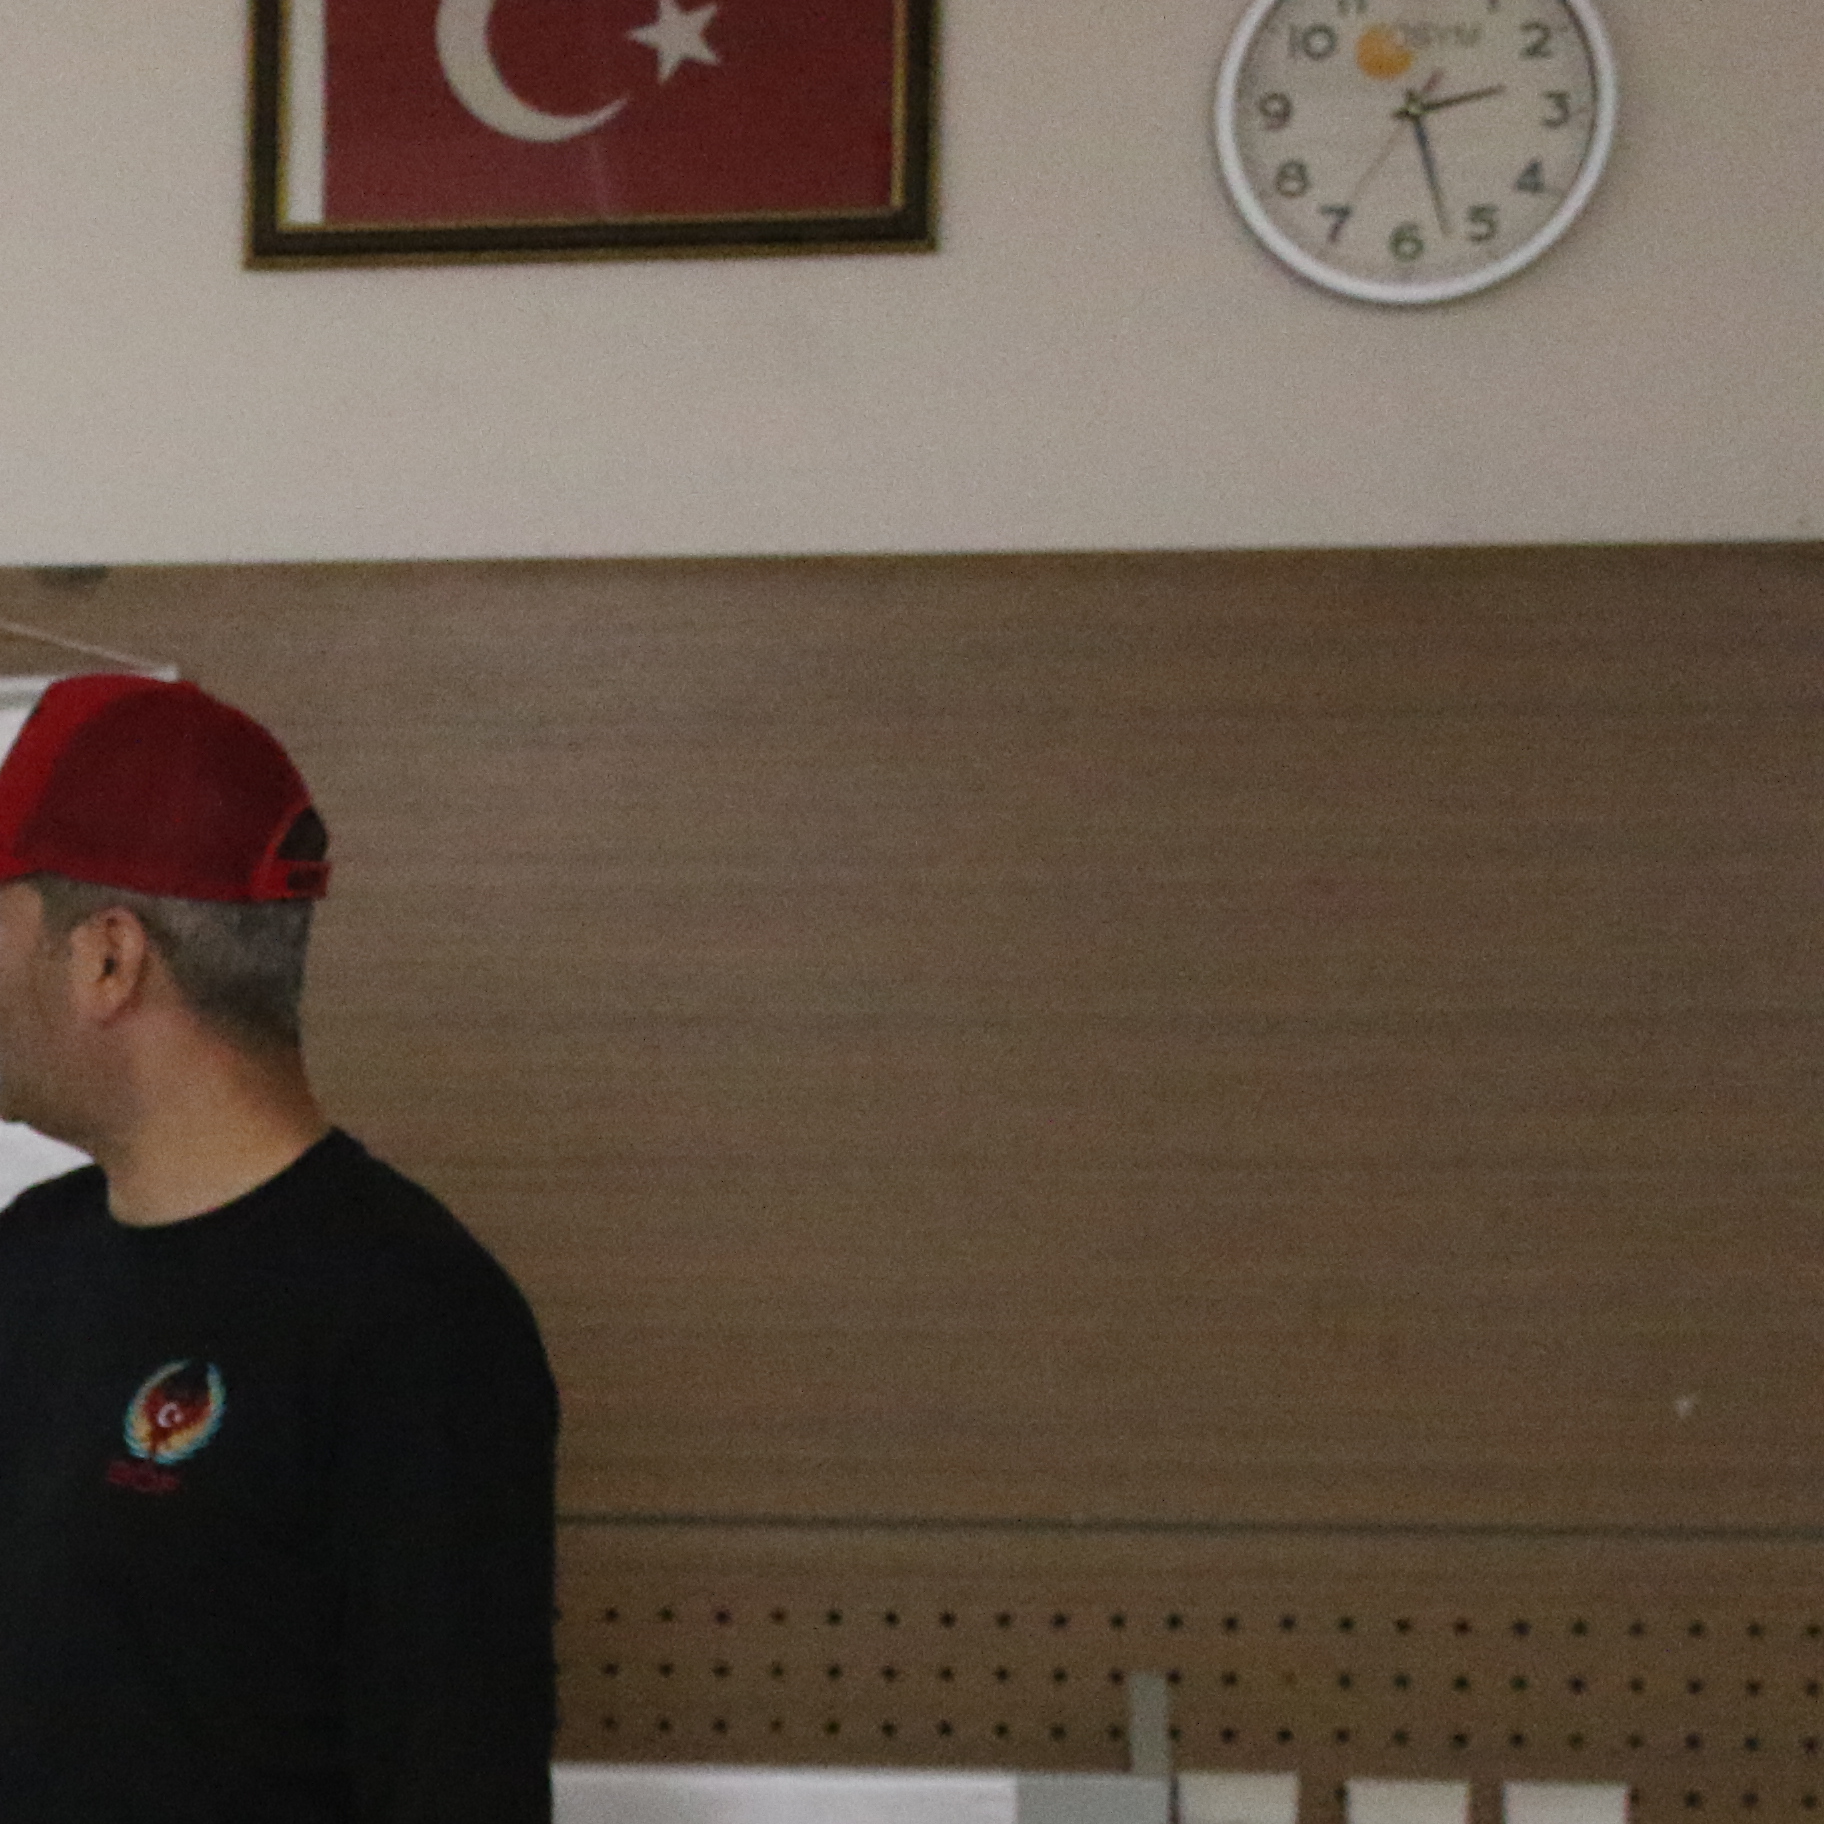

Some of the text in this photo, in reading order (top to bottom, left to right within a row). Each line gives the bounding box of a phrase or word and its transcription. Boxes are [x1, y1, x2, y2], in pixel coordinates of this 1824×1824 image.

[1288, 24, 1337, 60] 10
[1519, 20, 1552, 59] 2
[1259, 92, 1292, 131] 9
[1542, 89, 1570, 129] 3
[1275, 160, 1309, 198] 8
[1514, 157, 1545, 194] 4
[1319, 204, 1352, 243] 7
[1388, 222, 1425, 261] 6
[1467, 204, 1498, 243] 5
